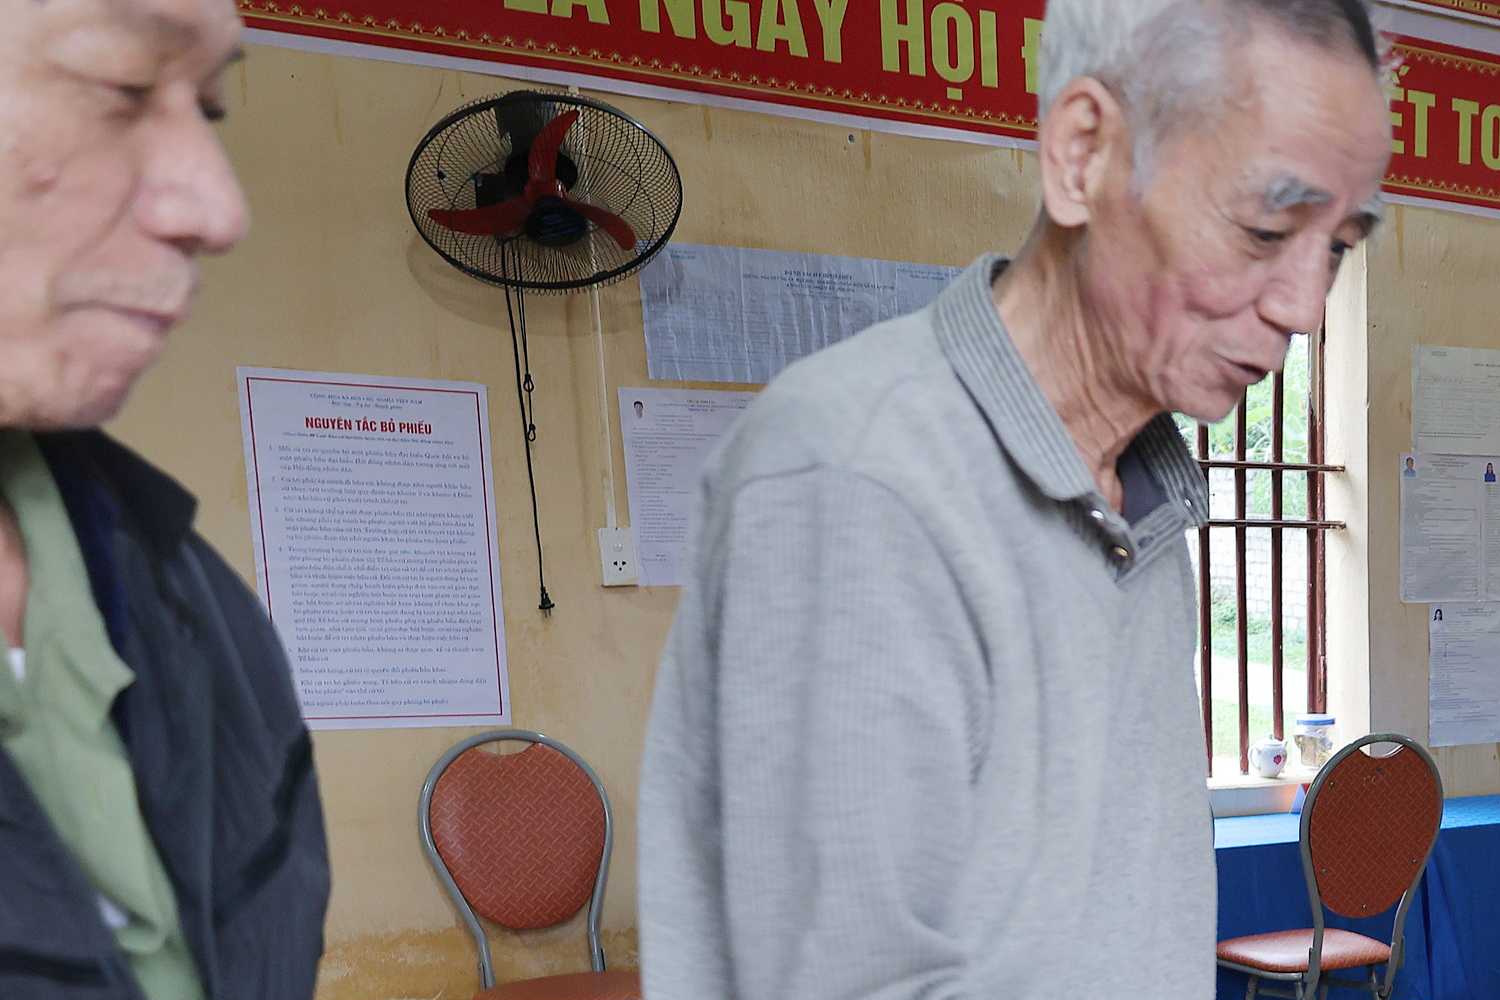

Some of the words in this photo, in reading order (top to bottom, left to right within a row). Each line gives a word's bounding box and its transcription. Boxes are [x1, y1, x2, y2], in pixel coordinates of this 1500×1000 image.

[1384, 64, 1436, 159] ẾT
[305, 415, 353, 431] NGUYÊN
[355, 415, 377, 432] TẮC
[380, 417, 396, 433] BỎ
[399, 419, 433, 435] PHIẾU
